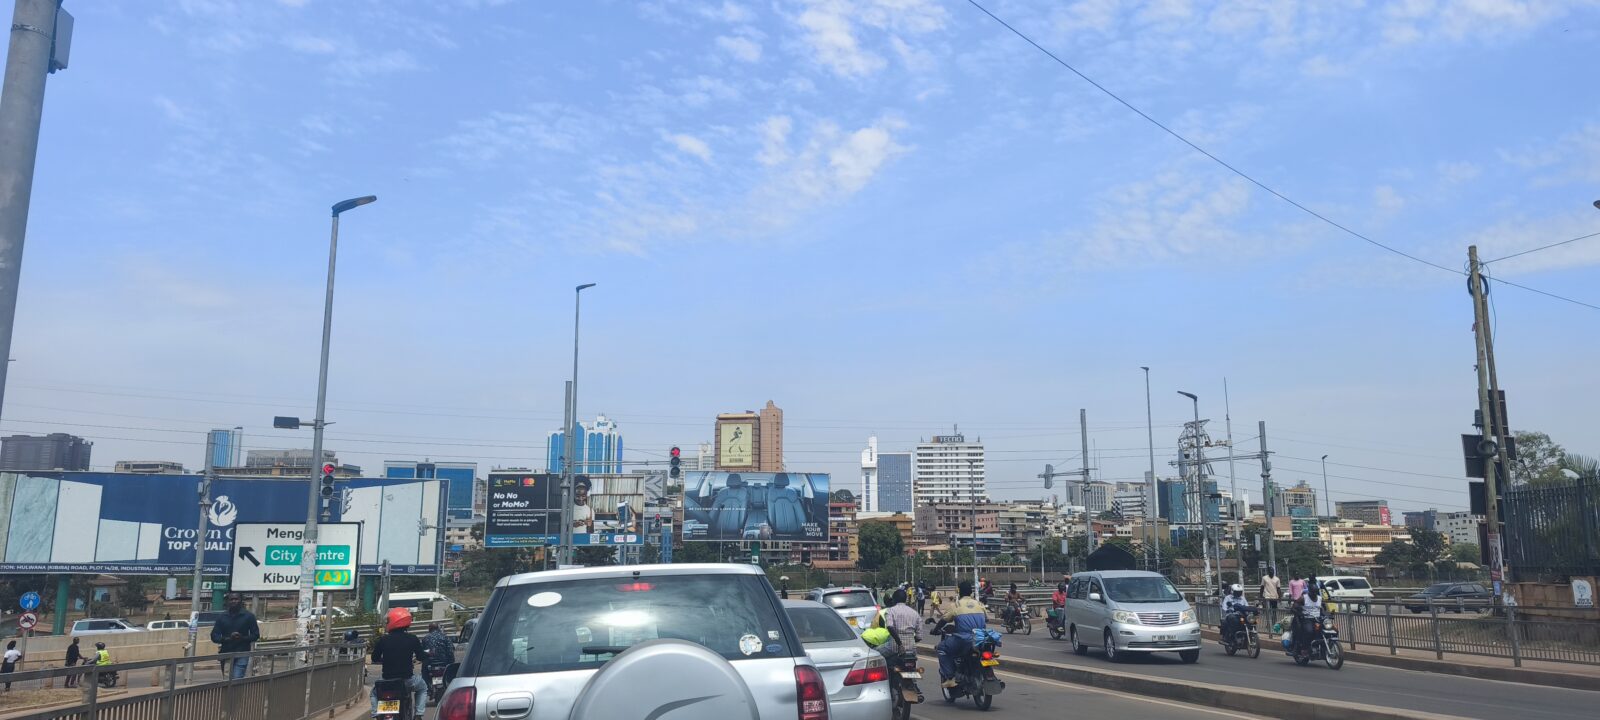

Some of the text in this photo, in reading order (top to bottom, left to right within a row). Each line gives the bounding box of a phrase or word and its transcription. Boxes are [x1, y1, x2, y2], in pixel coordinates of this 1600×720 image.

[501, 500, 530, 508] MoMo?
[267, 528, 303, 540] Meng
[167, 541, 191, 550] TOP
[270, 549, 345, 562] City entre
[263, 571, 349, 585] Kibuy (A3)
